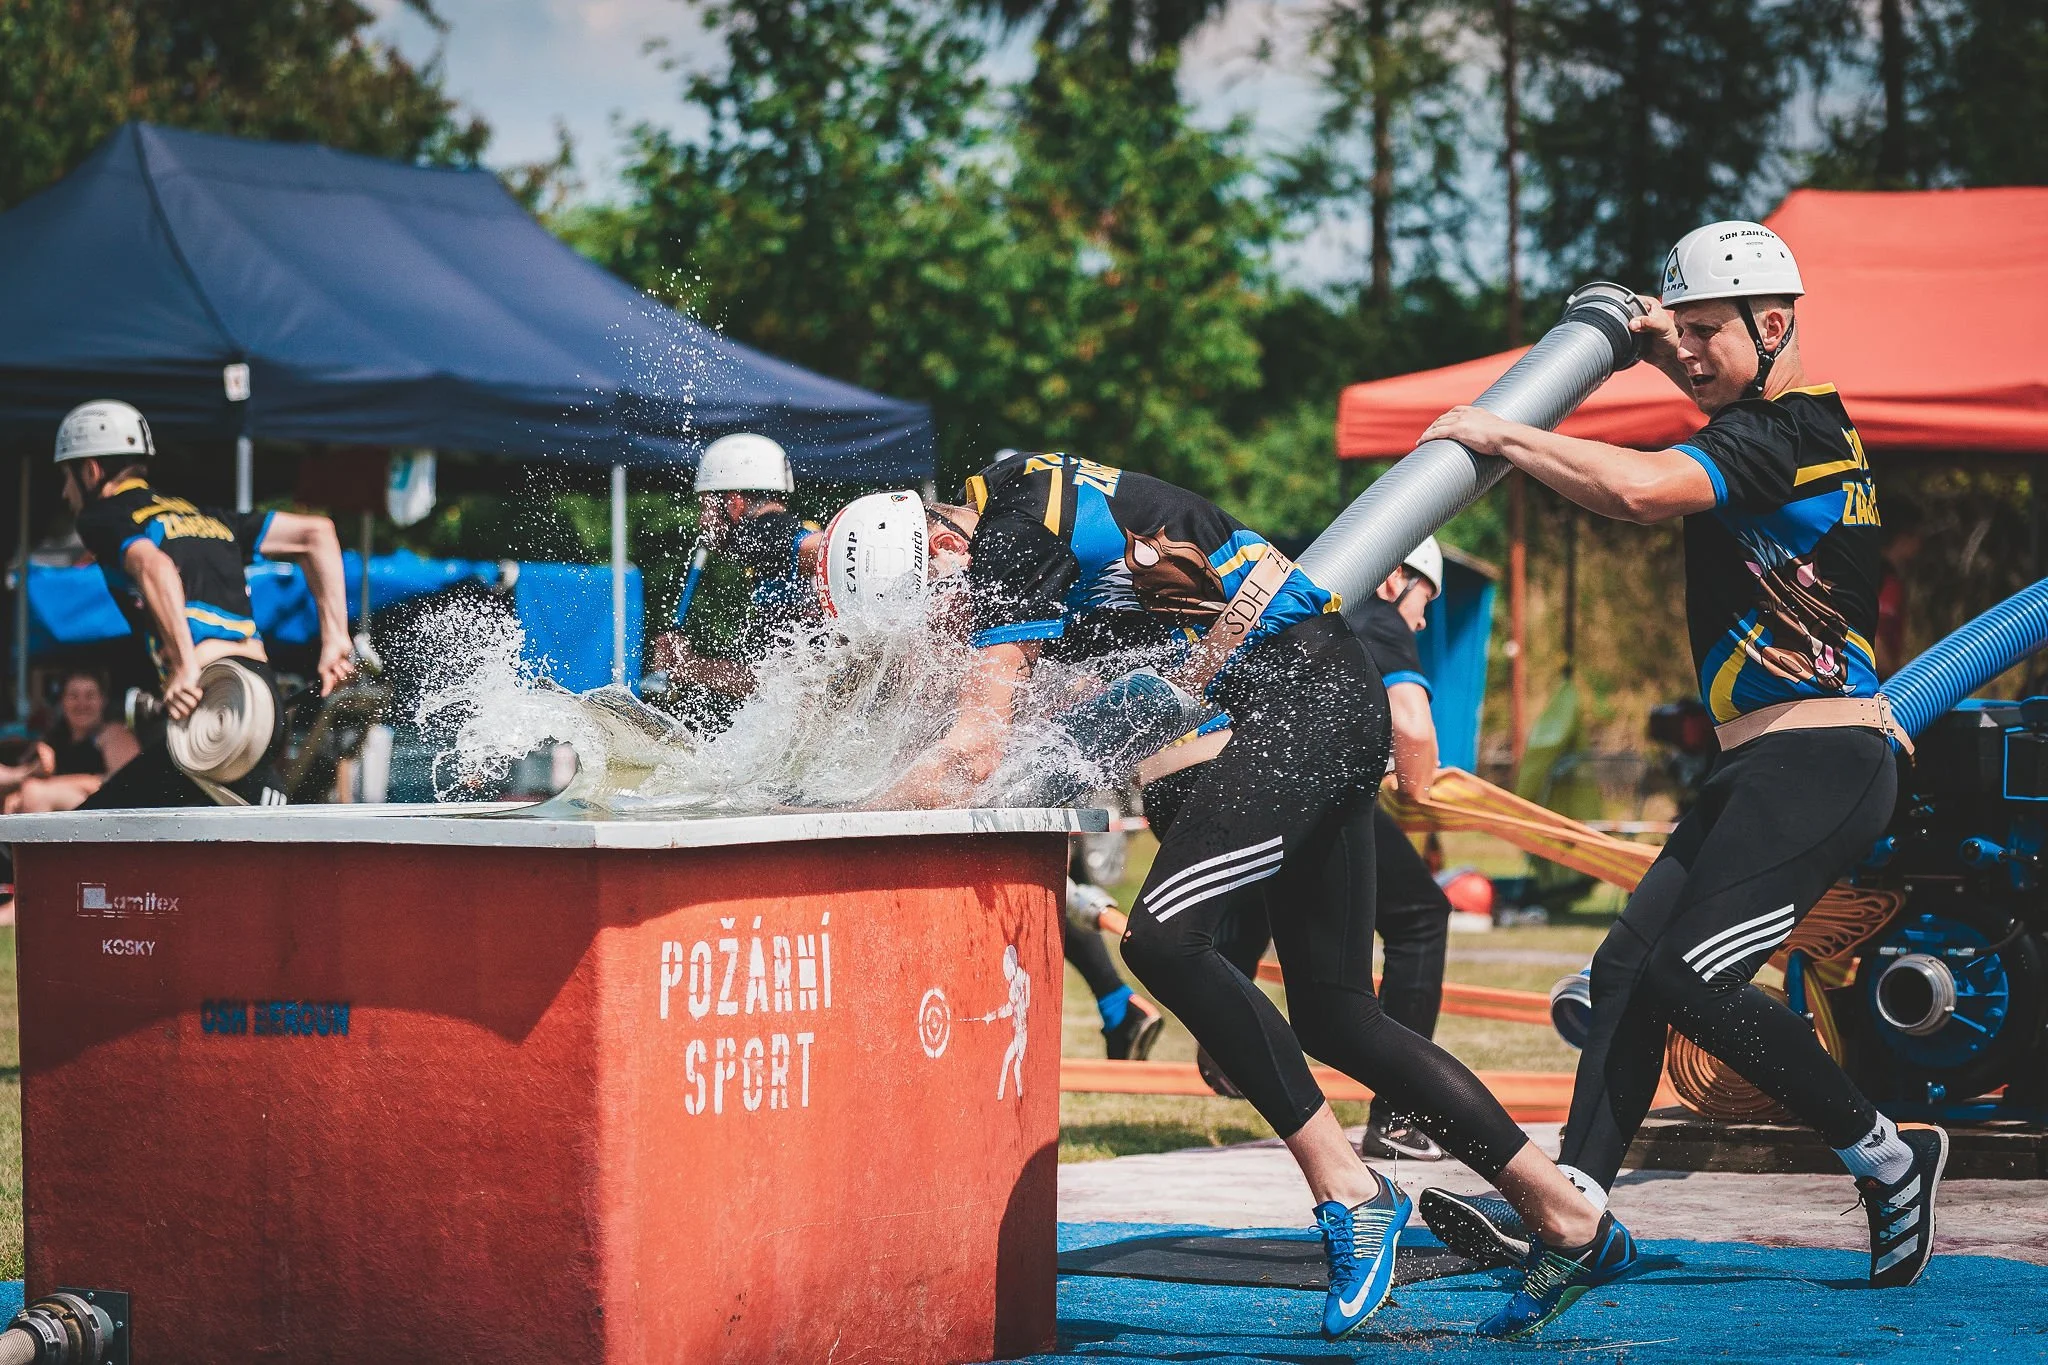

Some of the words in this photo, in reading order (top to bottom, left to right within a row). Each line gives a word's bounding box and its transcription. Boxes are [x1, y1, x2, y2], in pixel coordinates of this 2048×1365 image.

[1719, 231, 1738, 242] SDH
[1663, 282, 1684, 292] CAMP
[846, 531, 858, 594] CAMP
[1224, 580, 1271, 635] SDH
[102, 939, 156, 956] KOSKY
[660, 911, 832, 1020] POŽÁRNÍ
[684, 1032, 815, 1115] SPORT
